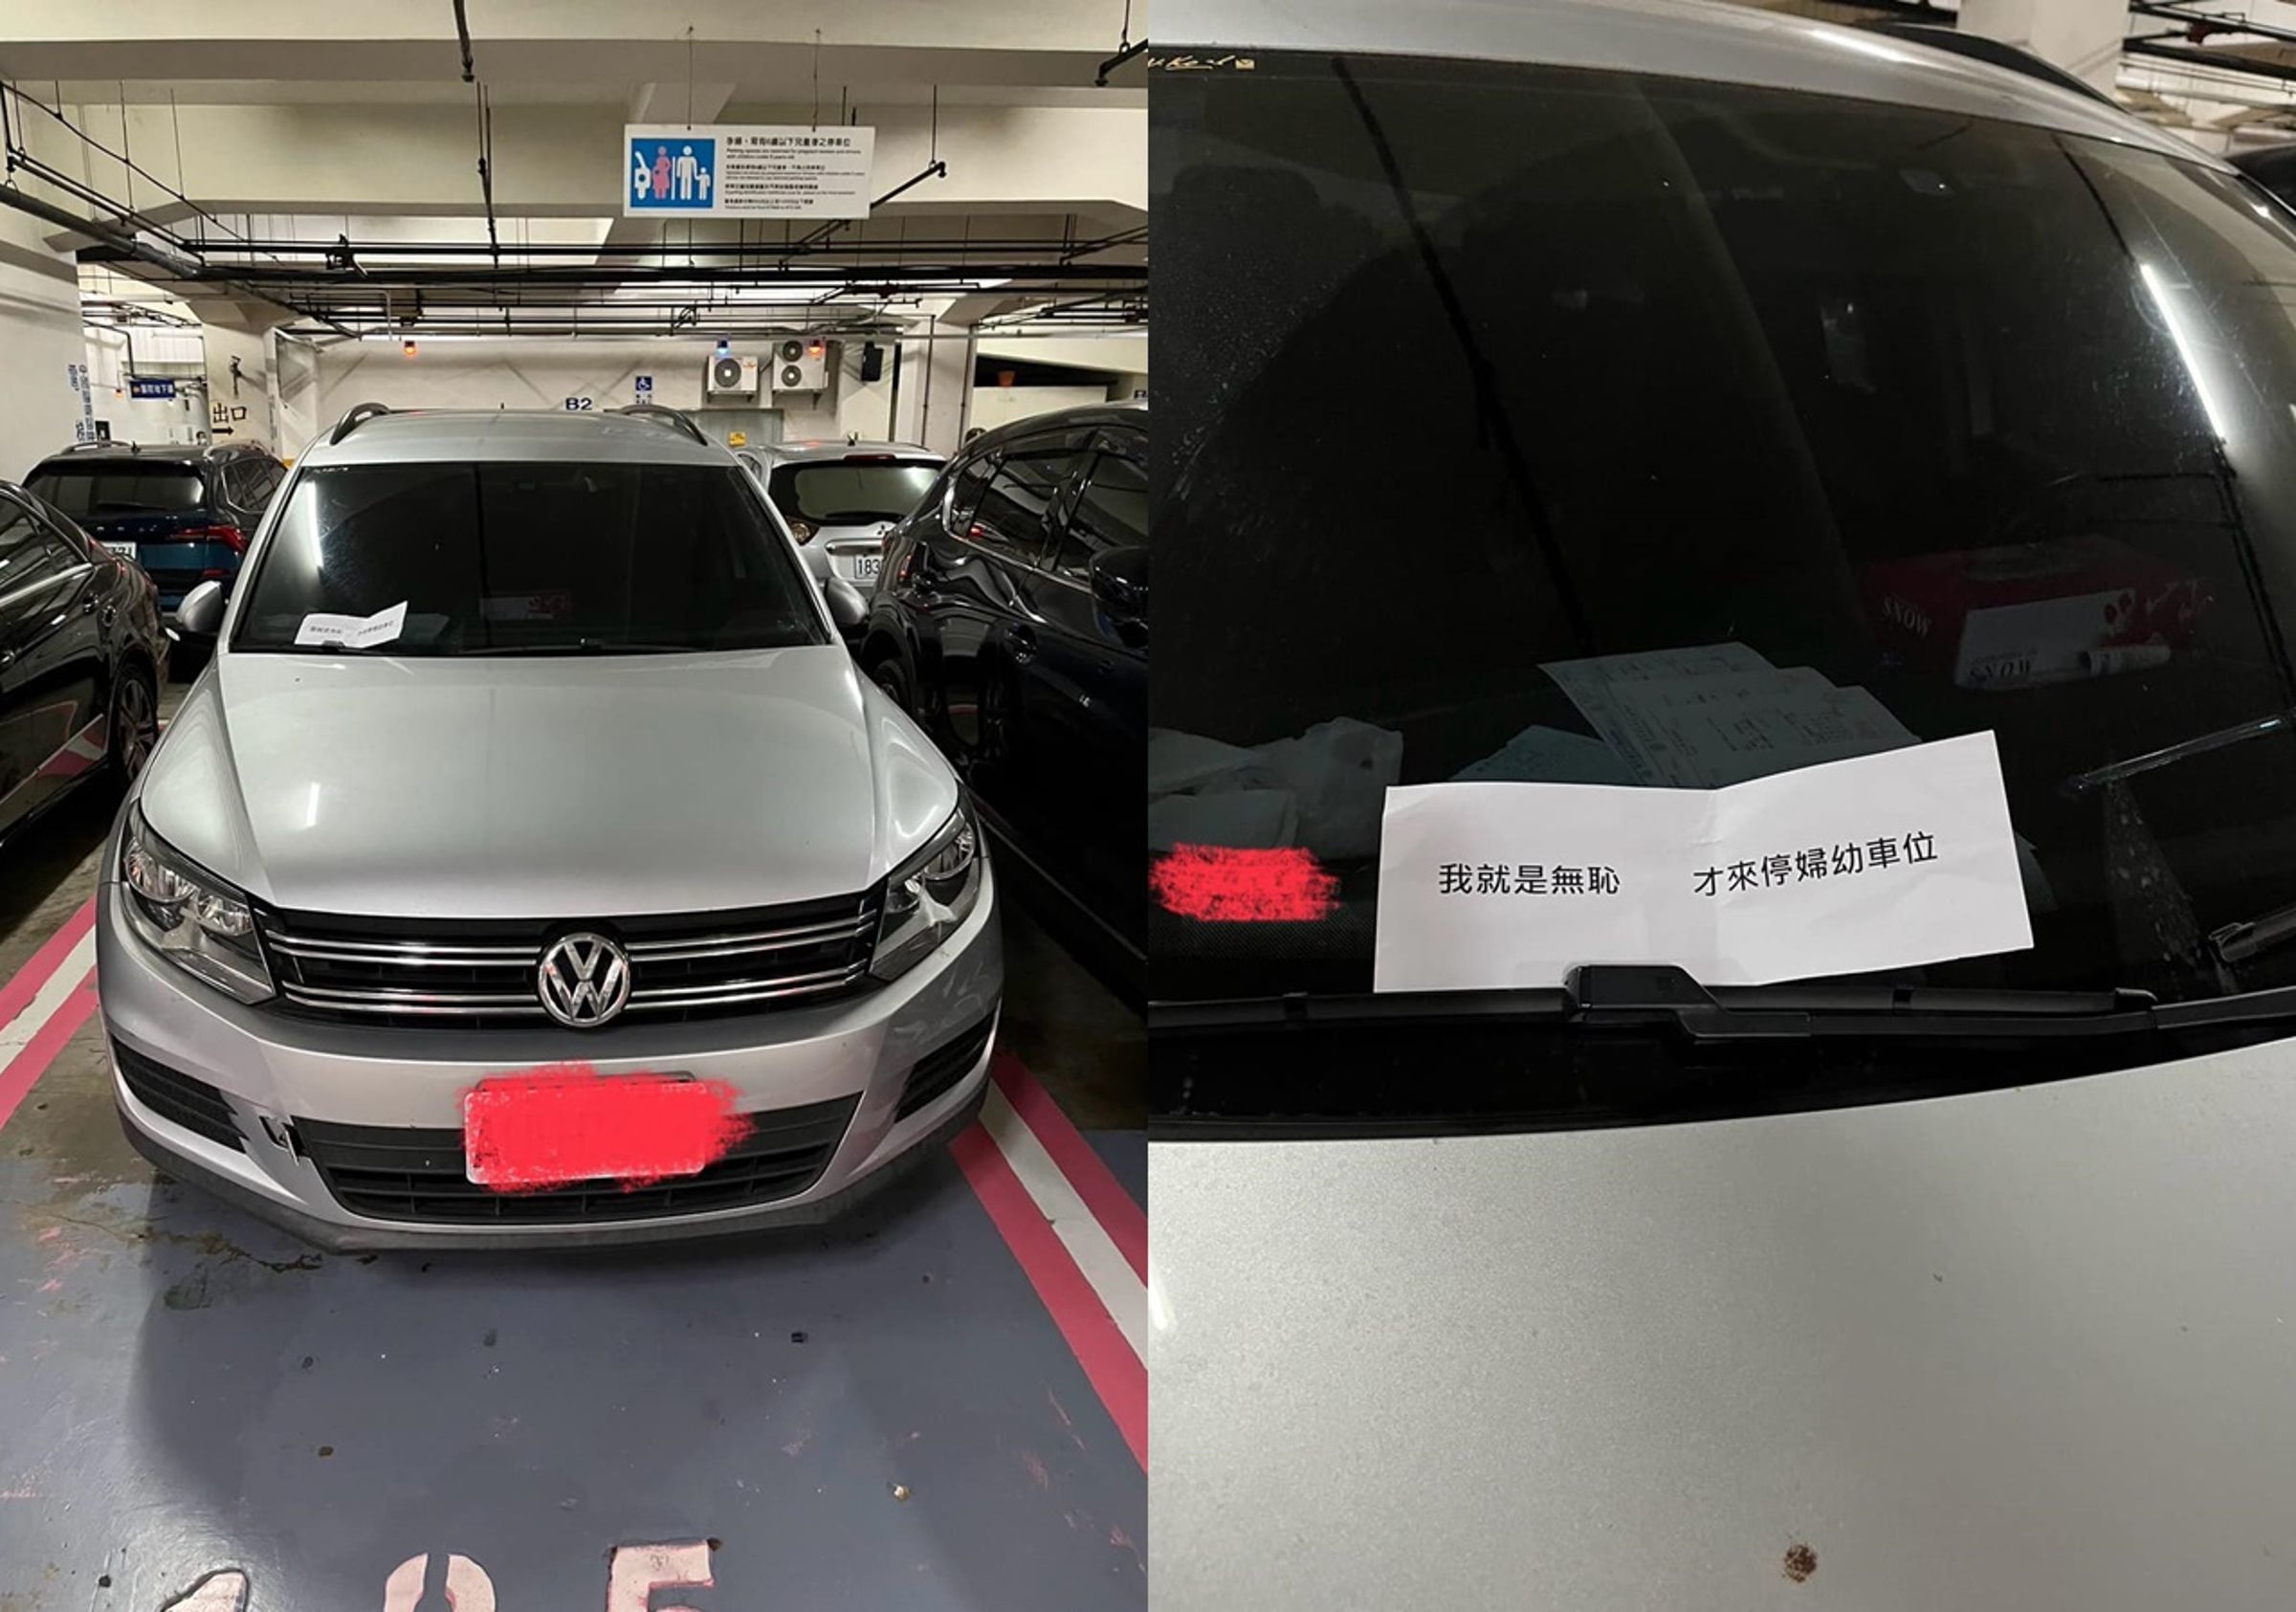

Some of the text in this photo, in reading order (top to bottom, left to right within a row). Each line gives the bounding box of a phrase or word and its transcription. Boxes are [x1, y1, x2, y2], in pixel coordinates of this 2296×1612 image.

[211, 403, 247, 424] 出口
[564, 397, 592, 411] B2
[857, 559, 882, 575] 183
[1882, 595, 1932, 641] SNOW
[1439, 830, 1937, 897] 我就是無恥 才來停婦幼車位
